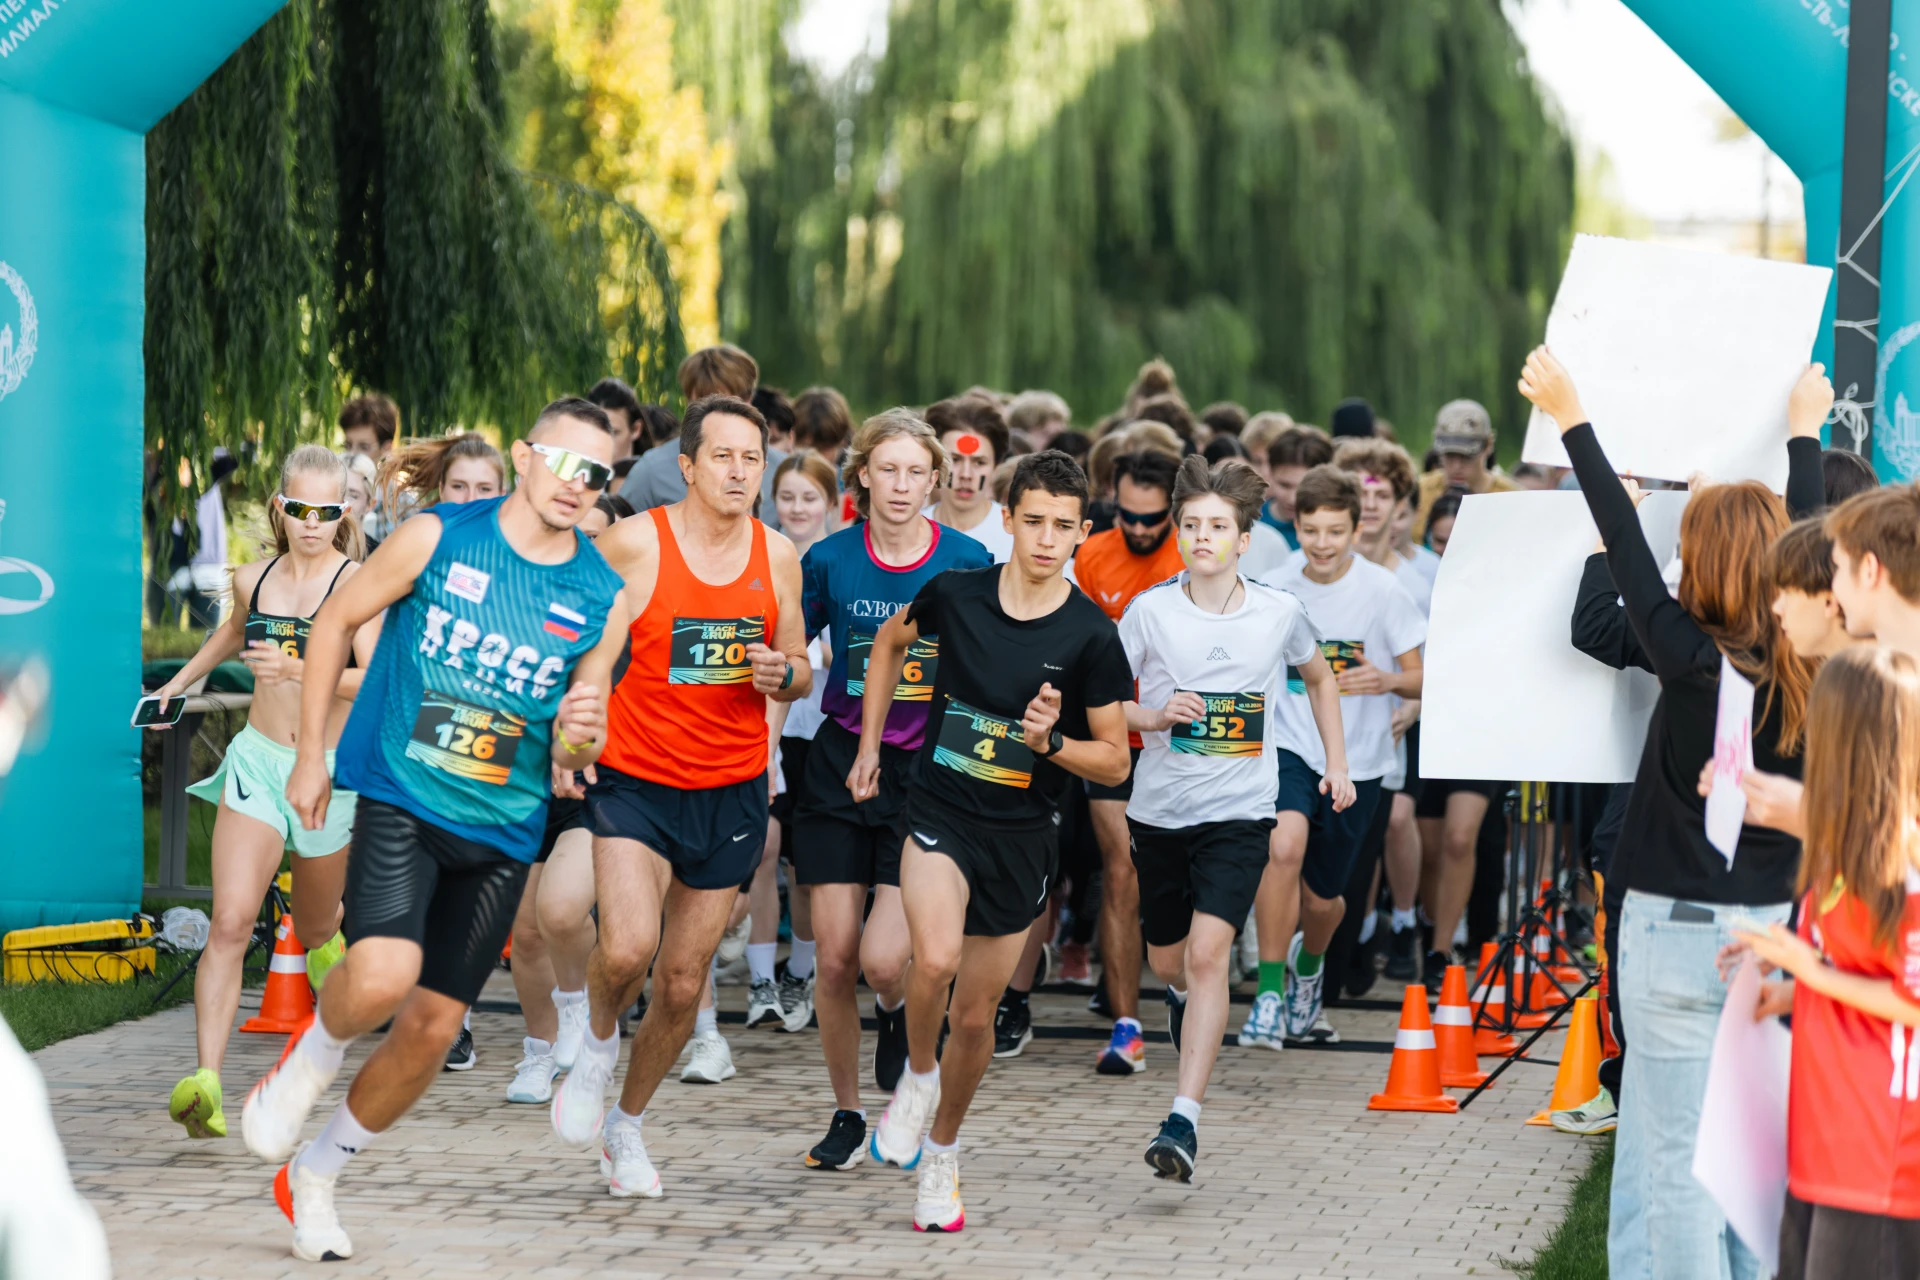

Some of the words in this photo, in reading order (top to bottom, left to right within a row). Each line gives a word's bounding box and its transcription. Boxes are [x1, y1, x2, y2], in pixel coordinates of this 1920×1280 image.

[701, 631, 736, 640] &RUN
[702, 625, 737, 633] TEACH
[424, 603, 565, 687] КРОСС
[688, 643, 746, 666] 120
[1204, 704, 1236, 714] RUN
[1190, 715, 1246, 739] 552
[434, 721, 498, 760] 126
[972, 738, 996, 761] 4
